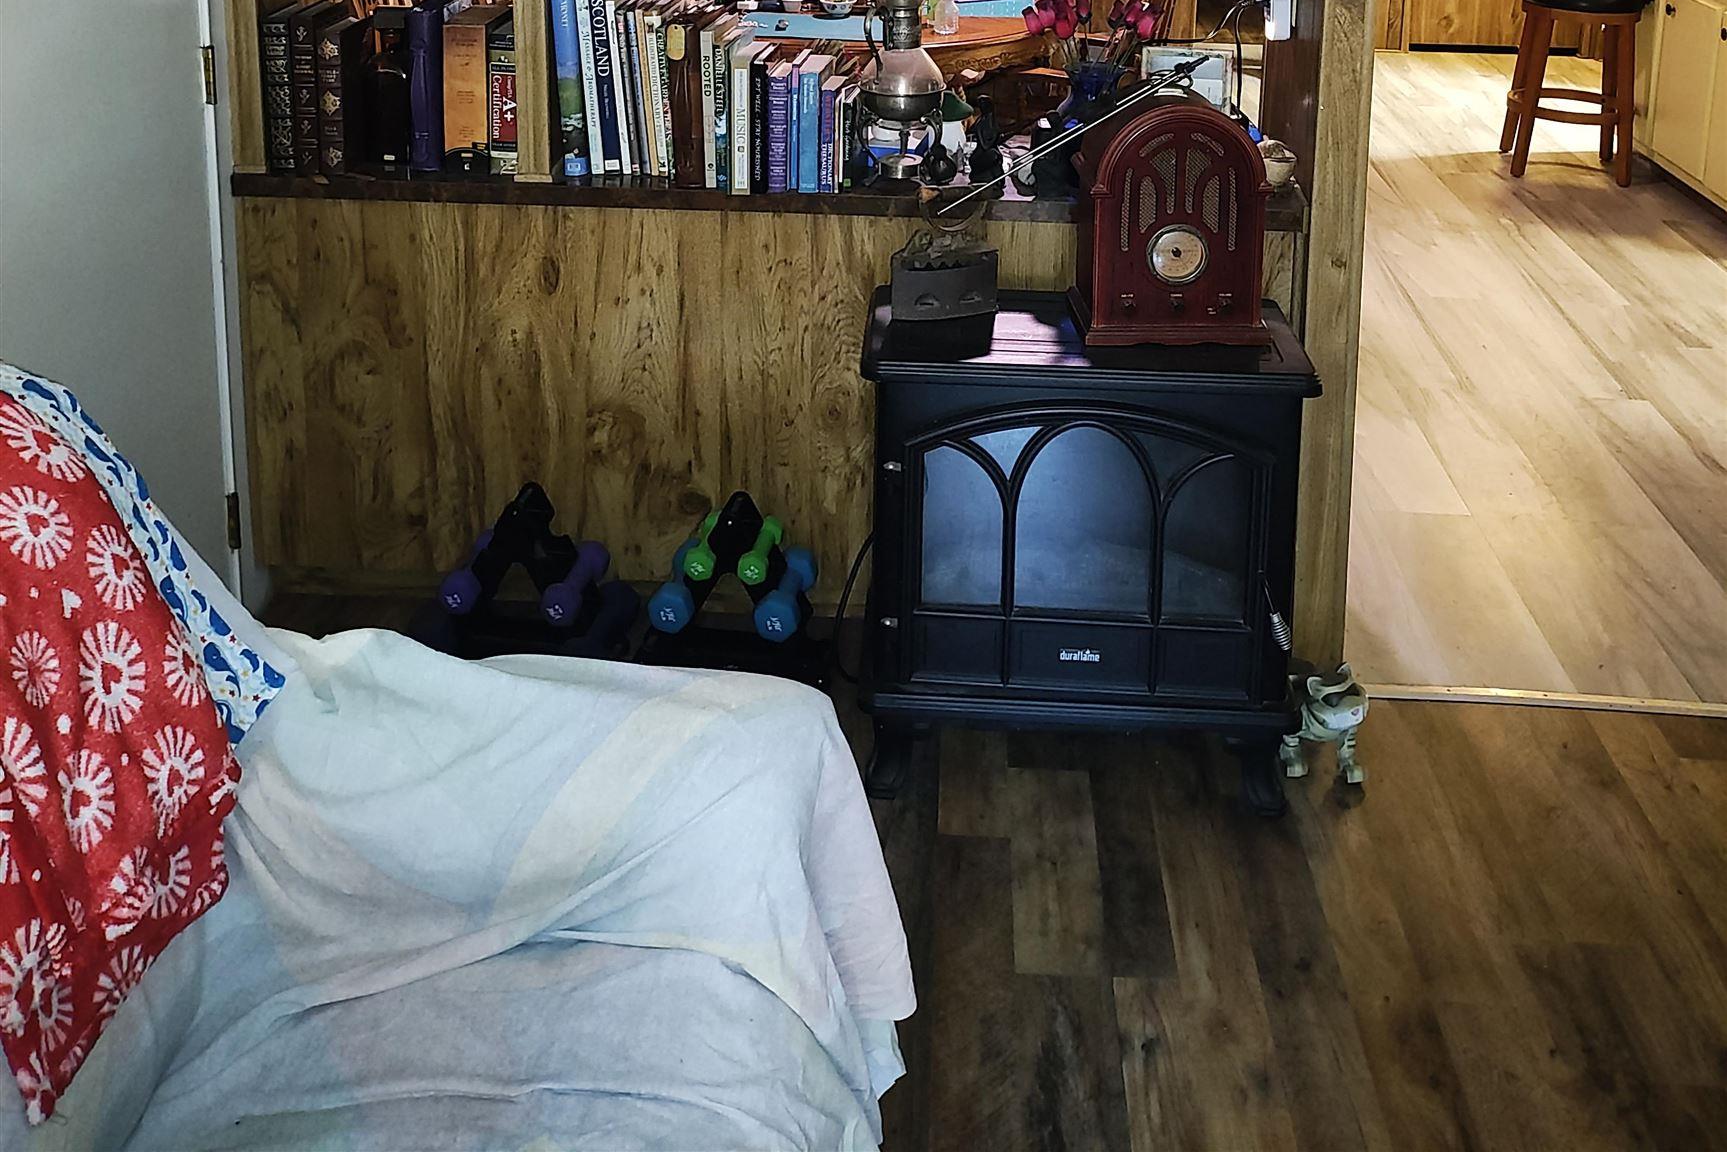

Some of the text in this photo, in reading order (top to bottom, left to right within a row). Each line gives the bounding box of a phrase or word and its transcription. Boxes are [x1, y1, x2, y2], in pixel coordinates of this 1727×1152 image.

[657, 32, 666, 75] CREATIVE
[650, 75, 659, 119] DICTIONARY
[659, 76, 669, 113] GARDEN
[703, 55, 712, 97] ROOTED
[714, 48, 724, 113] DANIELLE STEEL
[492, 75, 502, 139] Certification
[502, 97, 517, 122] A+
[736, 108, 746, 145] MUSIC
[1060, 650, 1100, 662] duraflame
